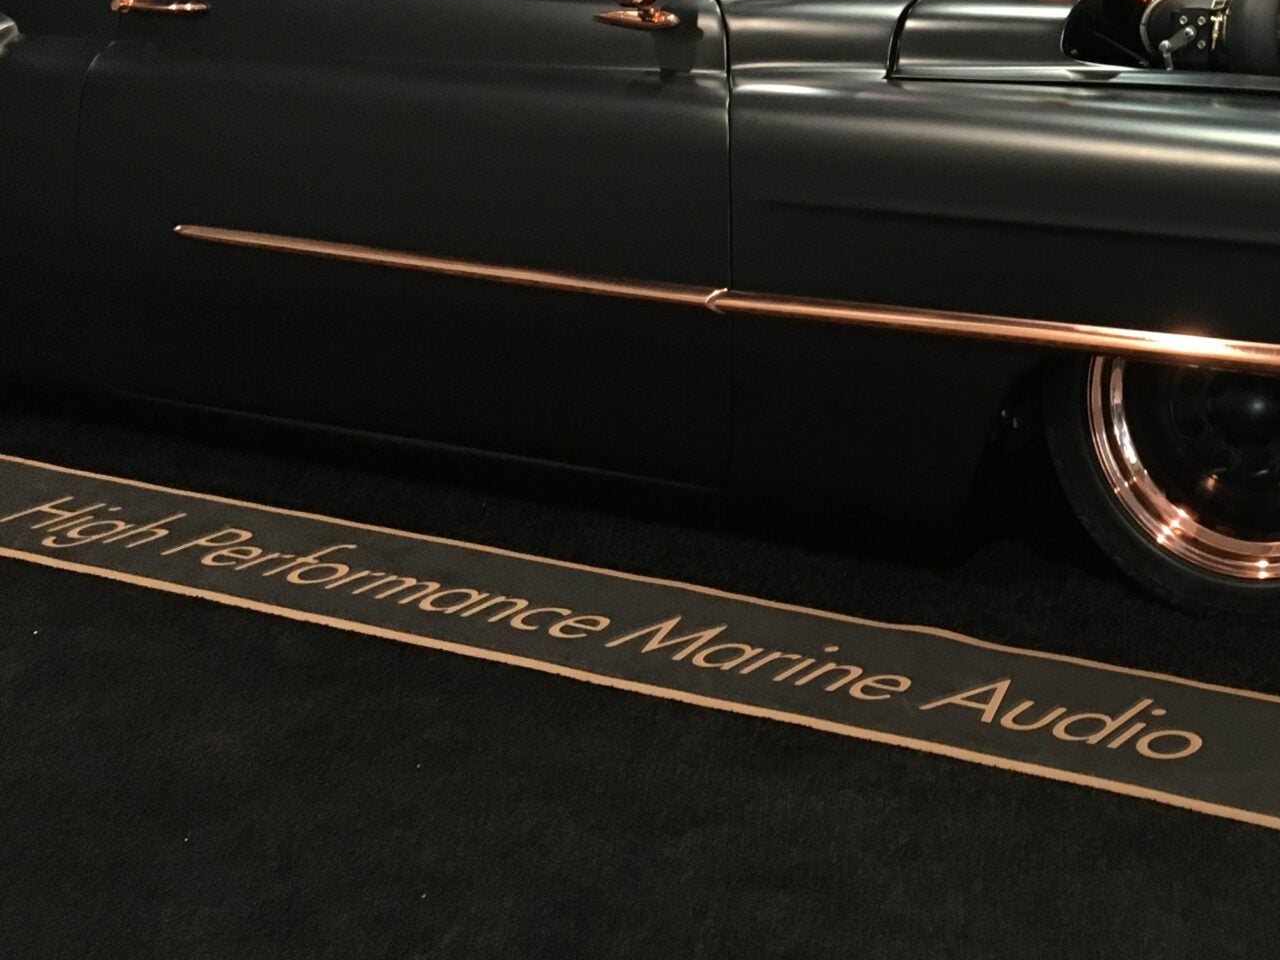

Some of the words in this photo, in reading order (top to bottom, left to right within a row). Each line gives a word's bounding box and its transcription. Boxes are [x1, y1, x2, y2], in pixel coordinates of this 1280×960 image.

[0, 496, 187, 547] High
[160, 528, 611, 638] Performance
[605, 615, 911, 701] Marine
[919, 678, 1203, 760] Audio
